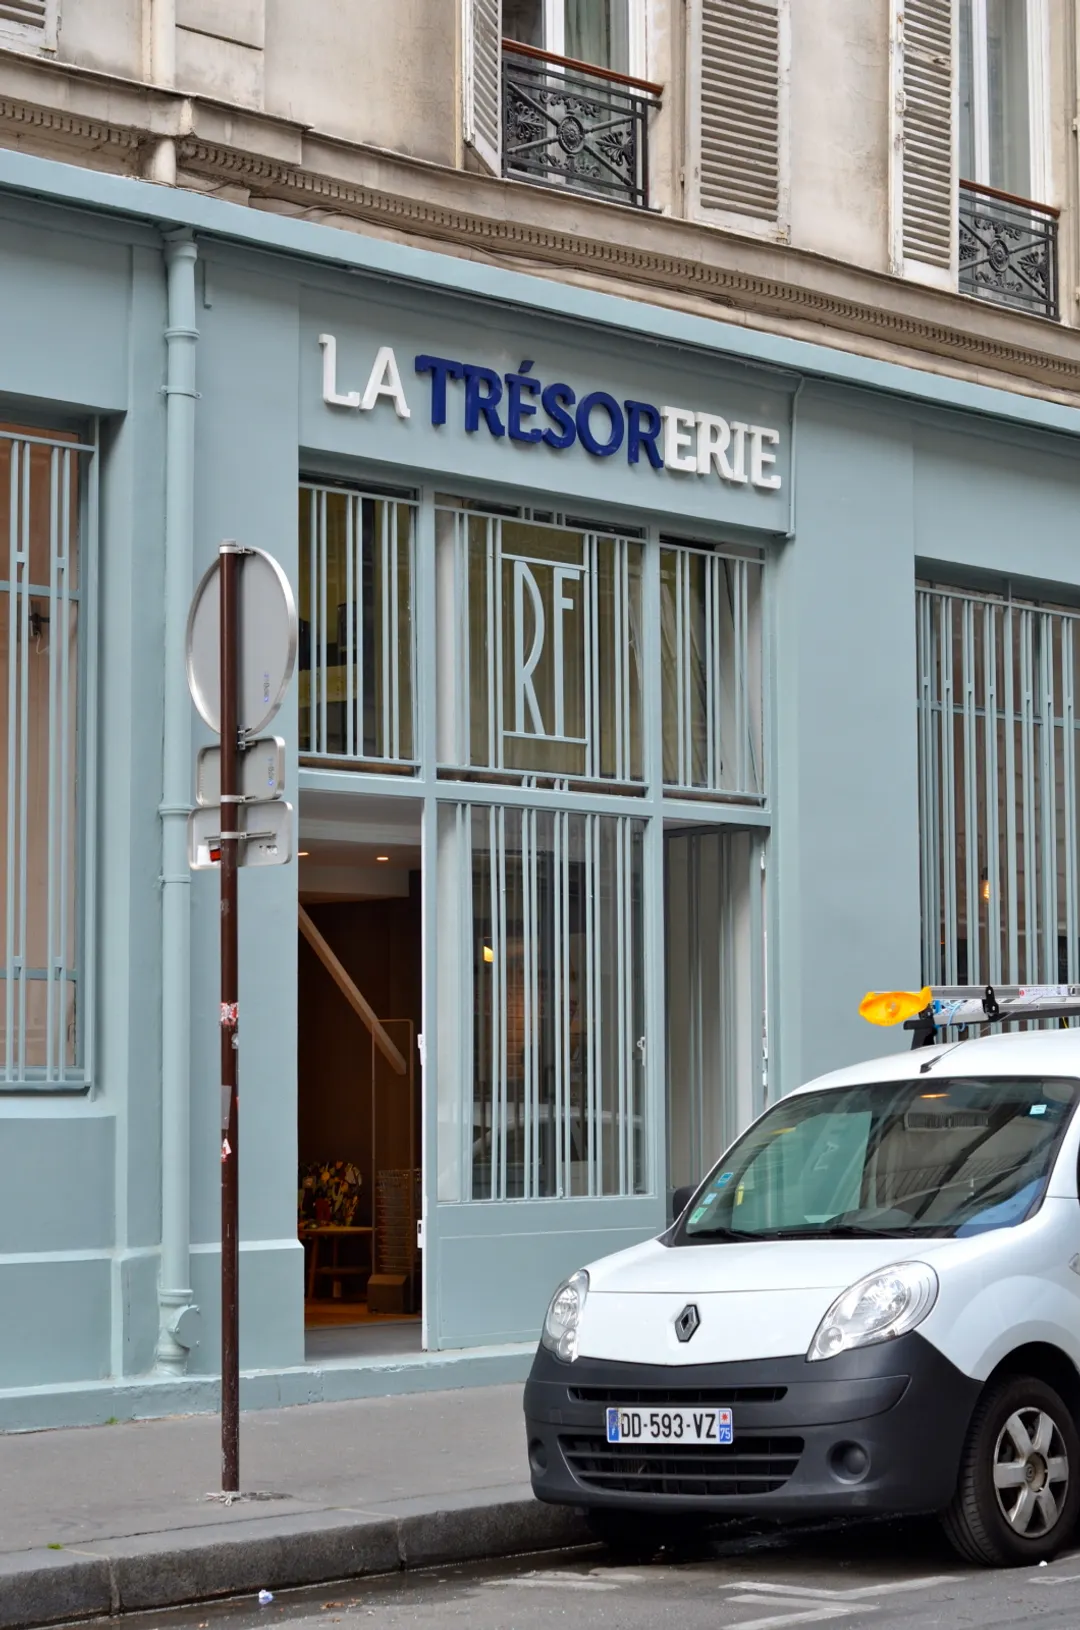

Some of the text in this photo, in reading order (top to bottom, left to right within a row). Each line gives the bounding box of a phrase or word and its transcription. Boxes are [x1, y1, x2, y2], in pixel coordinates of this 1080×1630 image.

[318, 333, 782, 489] LA TRÉSORERIE
[514, 560, 580, 737] RF
[620, 1412, 717, 1439] DD-593-VZ
[720, 1427, 731, 1440] 75
